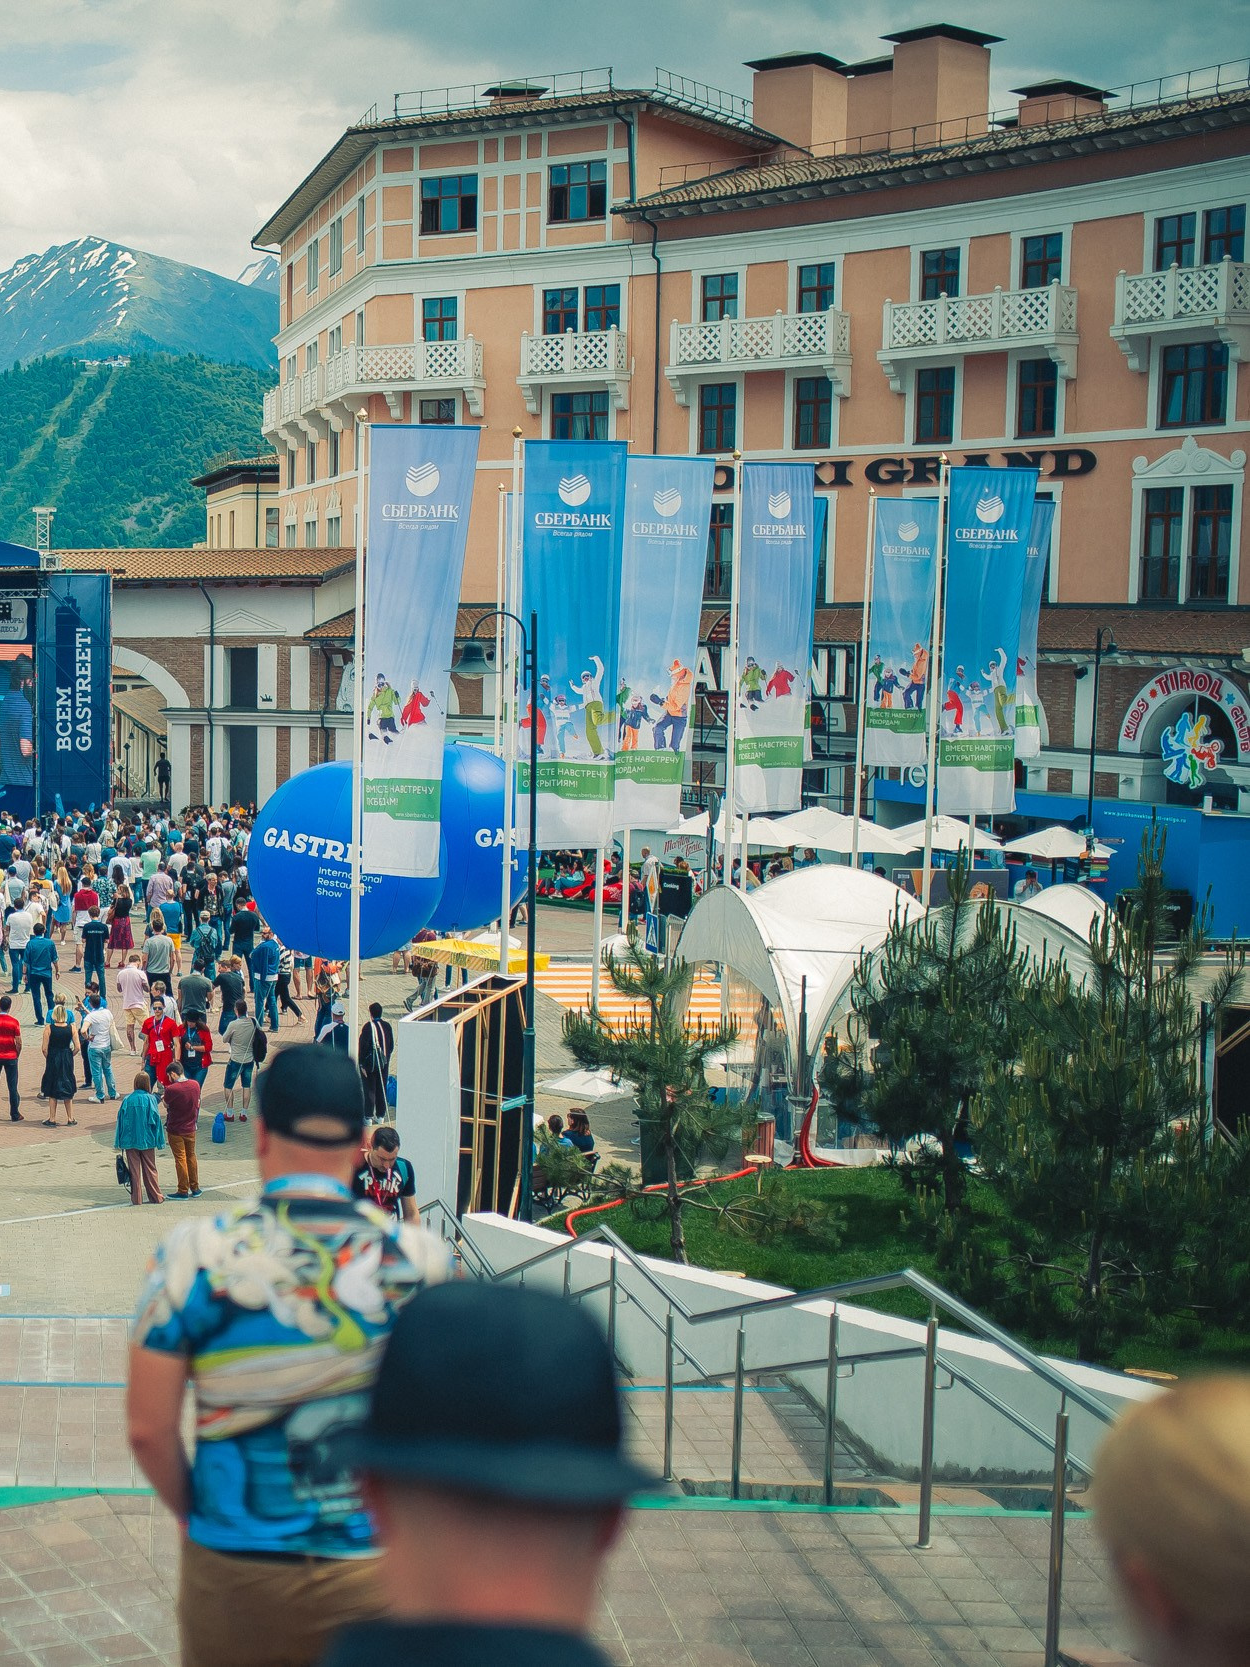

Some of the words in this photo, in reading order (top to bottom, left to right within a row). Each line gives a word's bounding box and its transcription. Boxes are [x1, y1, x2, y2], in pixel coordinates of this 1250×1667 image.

[382, 504, 459, 518] СБЕРБАНК
[535, 512, 611, 526] СБЕРБАНК
[632, 522, 698, 536] СБЕРБАНК
[752, 524, 806, 536] СБЕРБАНК
[955, 527, 1018, 540] СБЕРБАНК
[882, 545, 931, 556] СБЕРБАНК
[76, 627, 92, 751] GASTREET!
[1155, 671, 1224, 702] TIROL
[56, 687, 72, 751] ВСЕМ
[1123, 698, 1150, 741] KIDS
[1230, 705, 1250, 753] CLUB
[758, 741, 799, 749] НАВСТРЕЧУ
[945, 744, 974, 752] ВМЕСТЕ
[974, 744, 1012, 752] НАВСТРЕЧУ
[634, 755, 680, 764] НАВСТРЕЧУ
[945, 754, 992, 762] ОТКРЫТИЯМ!
[557, 768, 608, 778] НАВСТРЕЧУ
[316, 887, 342, 898] Show
